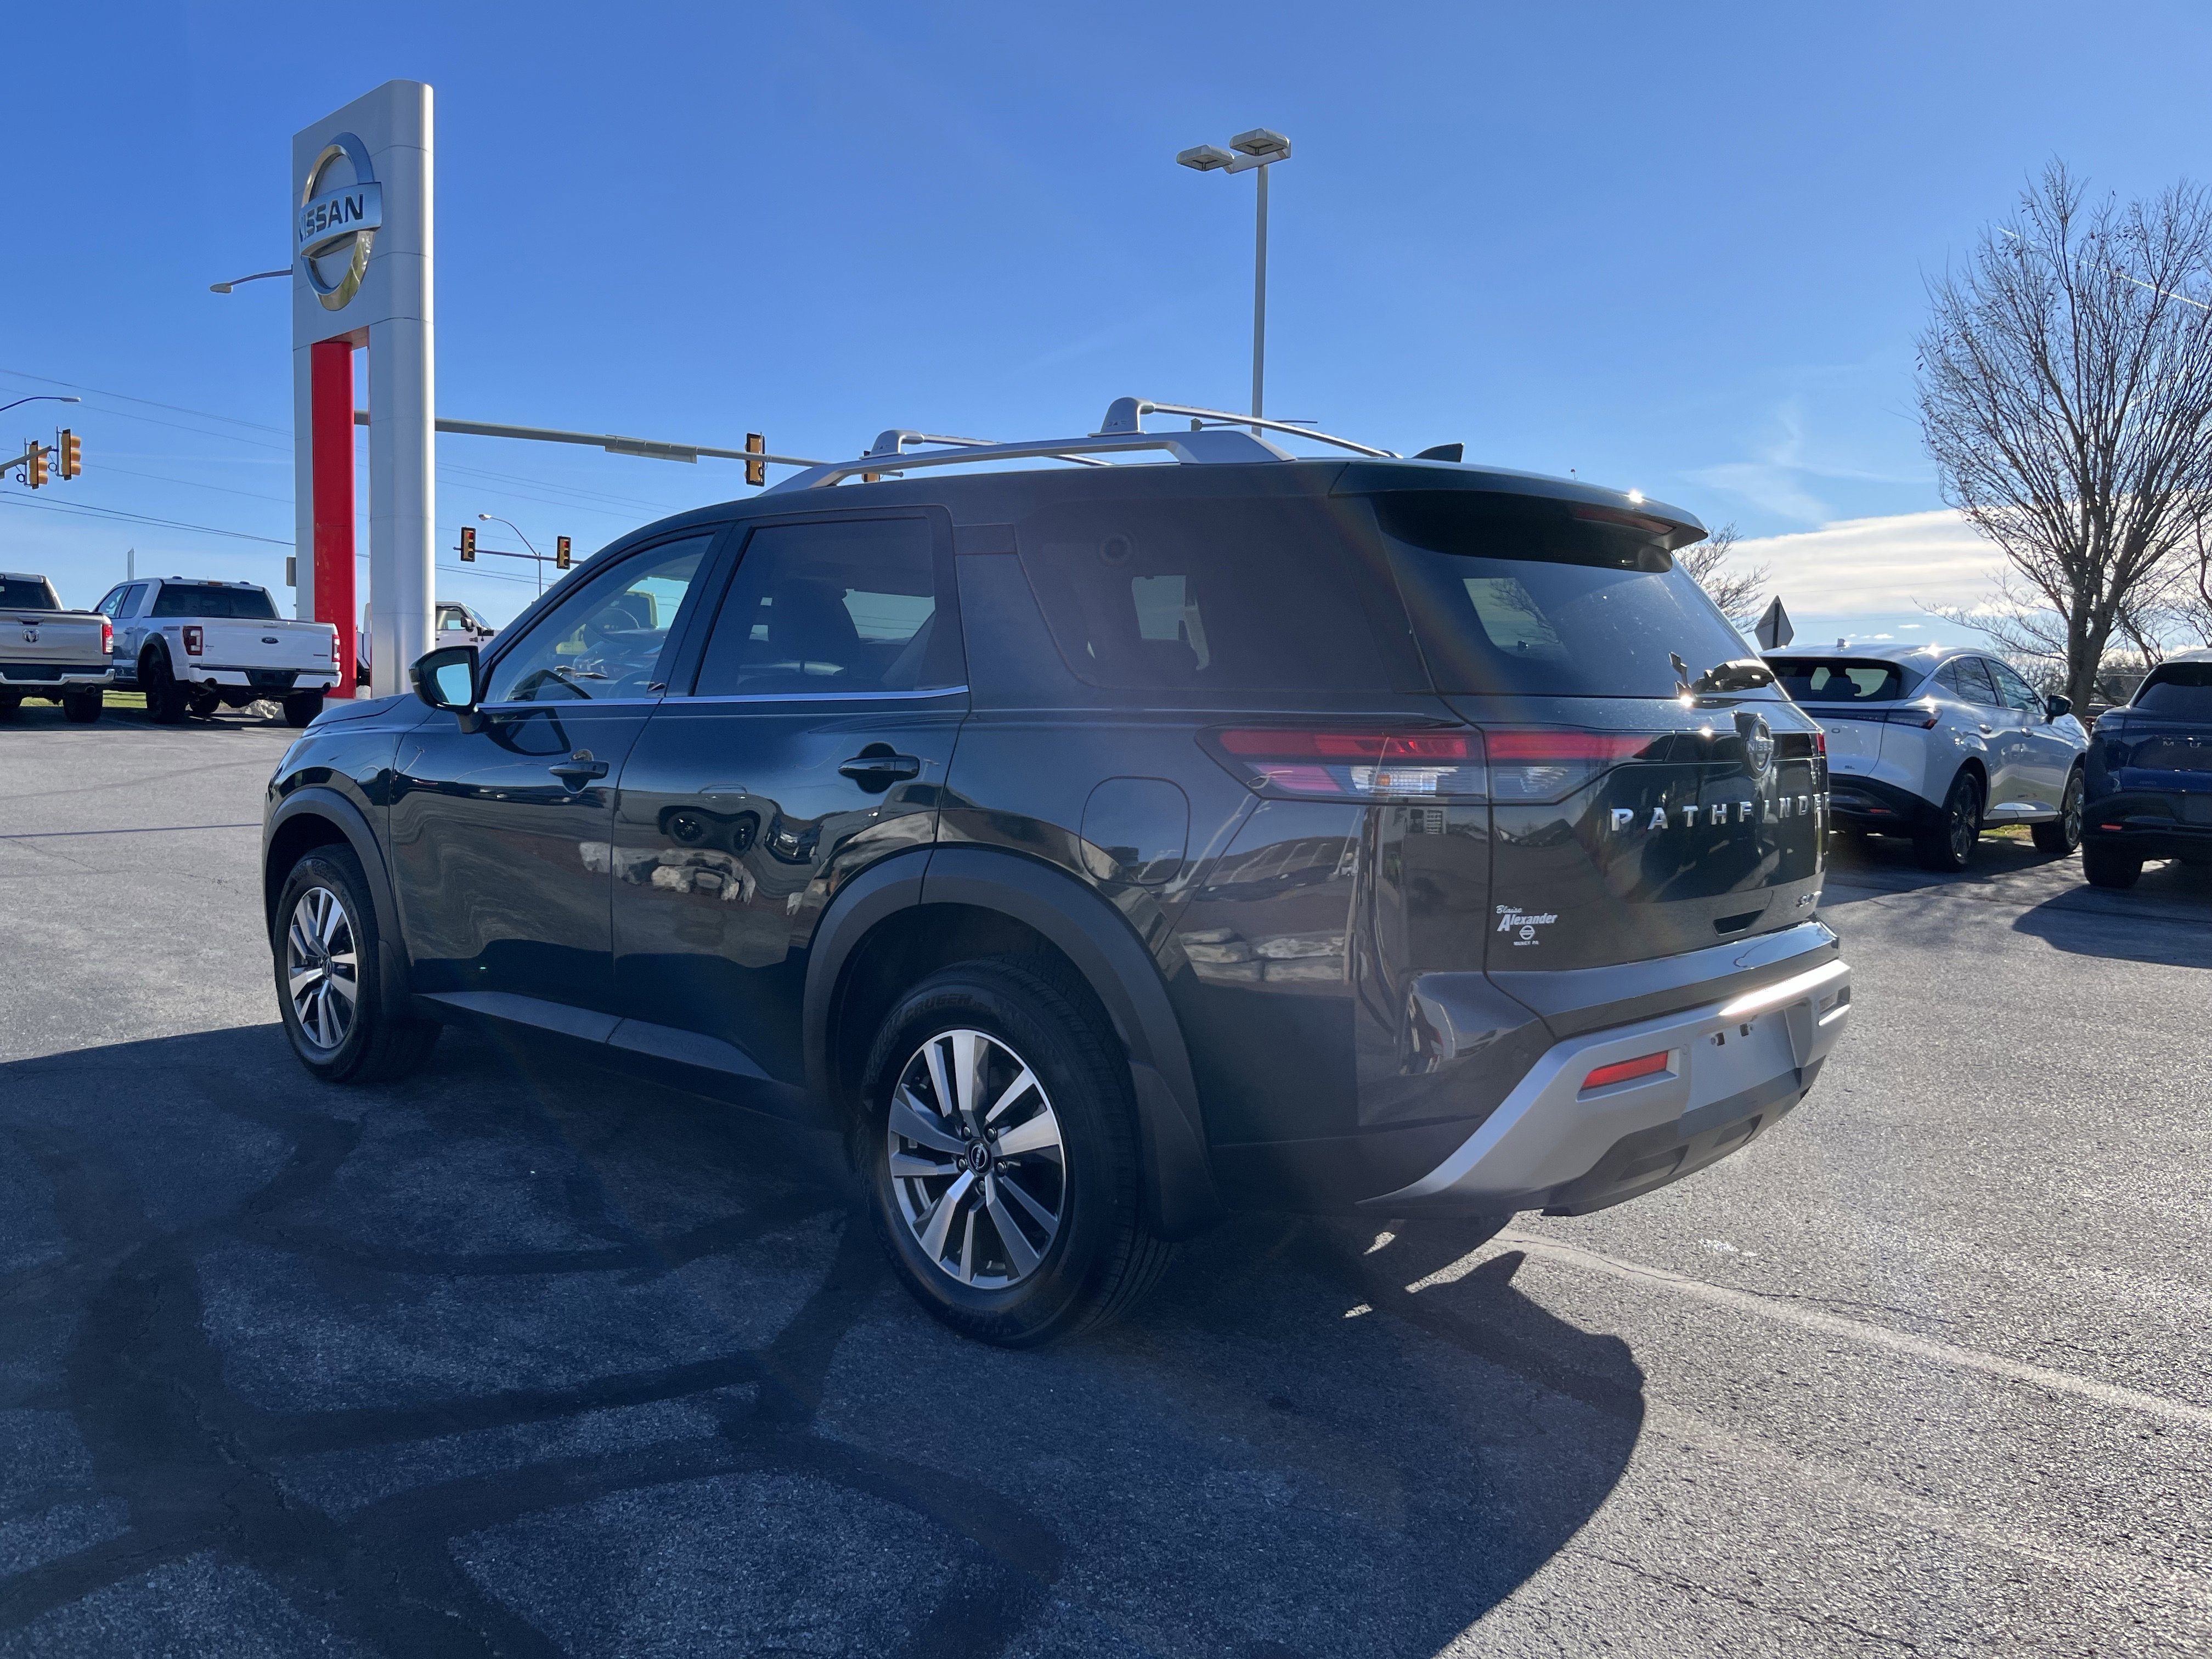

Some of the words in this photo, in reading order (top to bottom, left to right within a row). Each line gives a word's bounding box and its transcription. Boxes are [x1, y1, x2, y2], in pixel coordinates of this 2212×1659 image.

[299, 193, 364, 242] NISSAN
[1496, 905, 1522, 914] Blaise
[1497, 913, 1559, 932] Alexander
